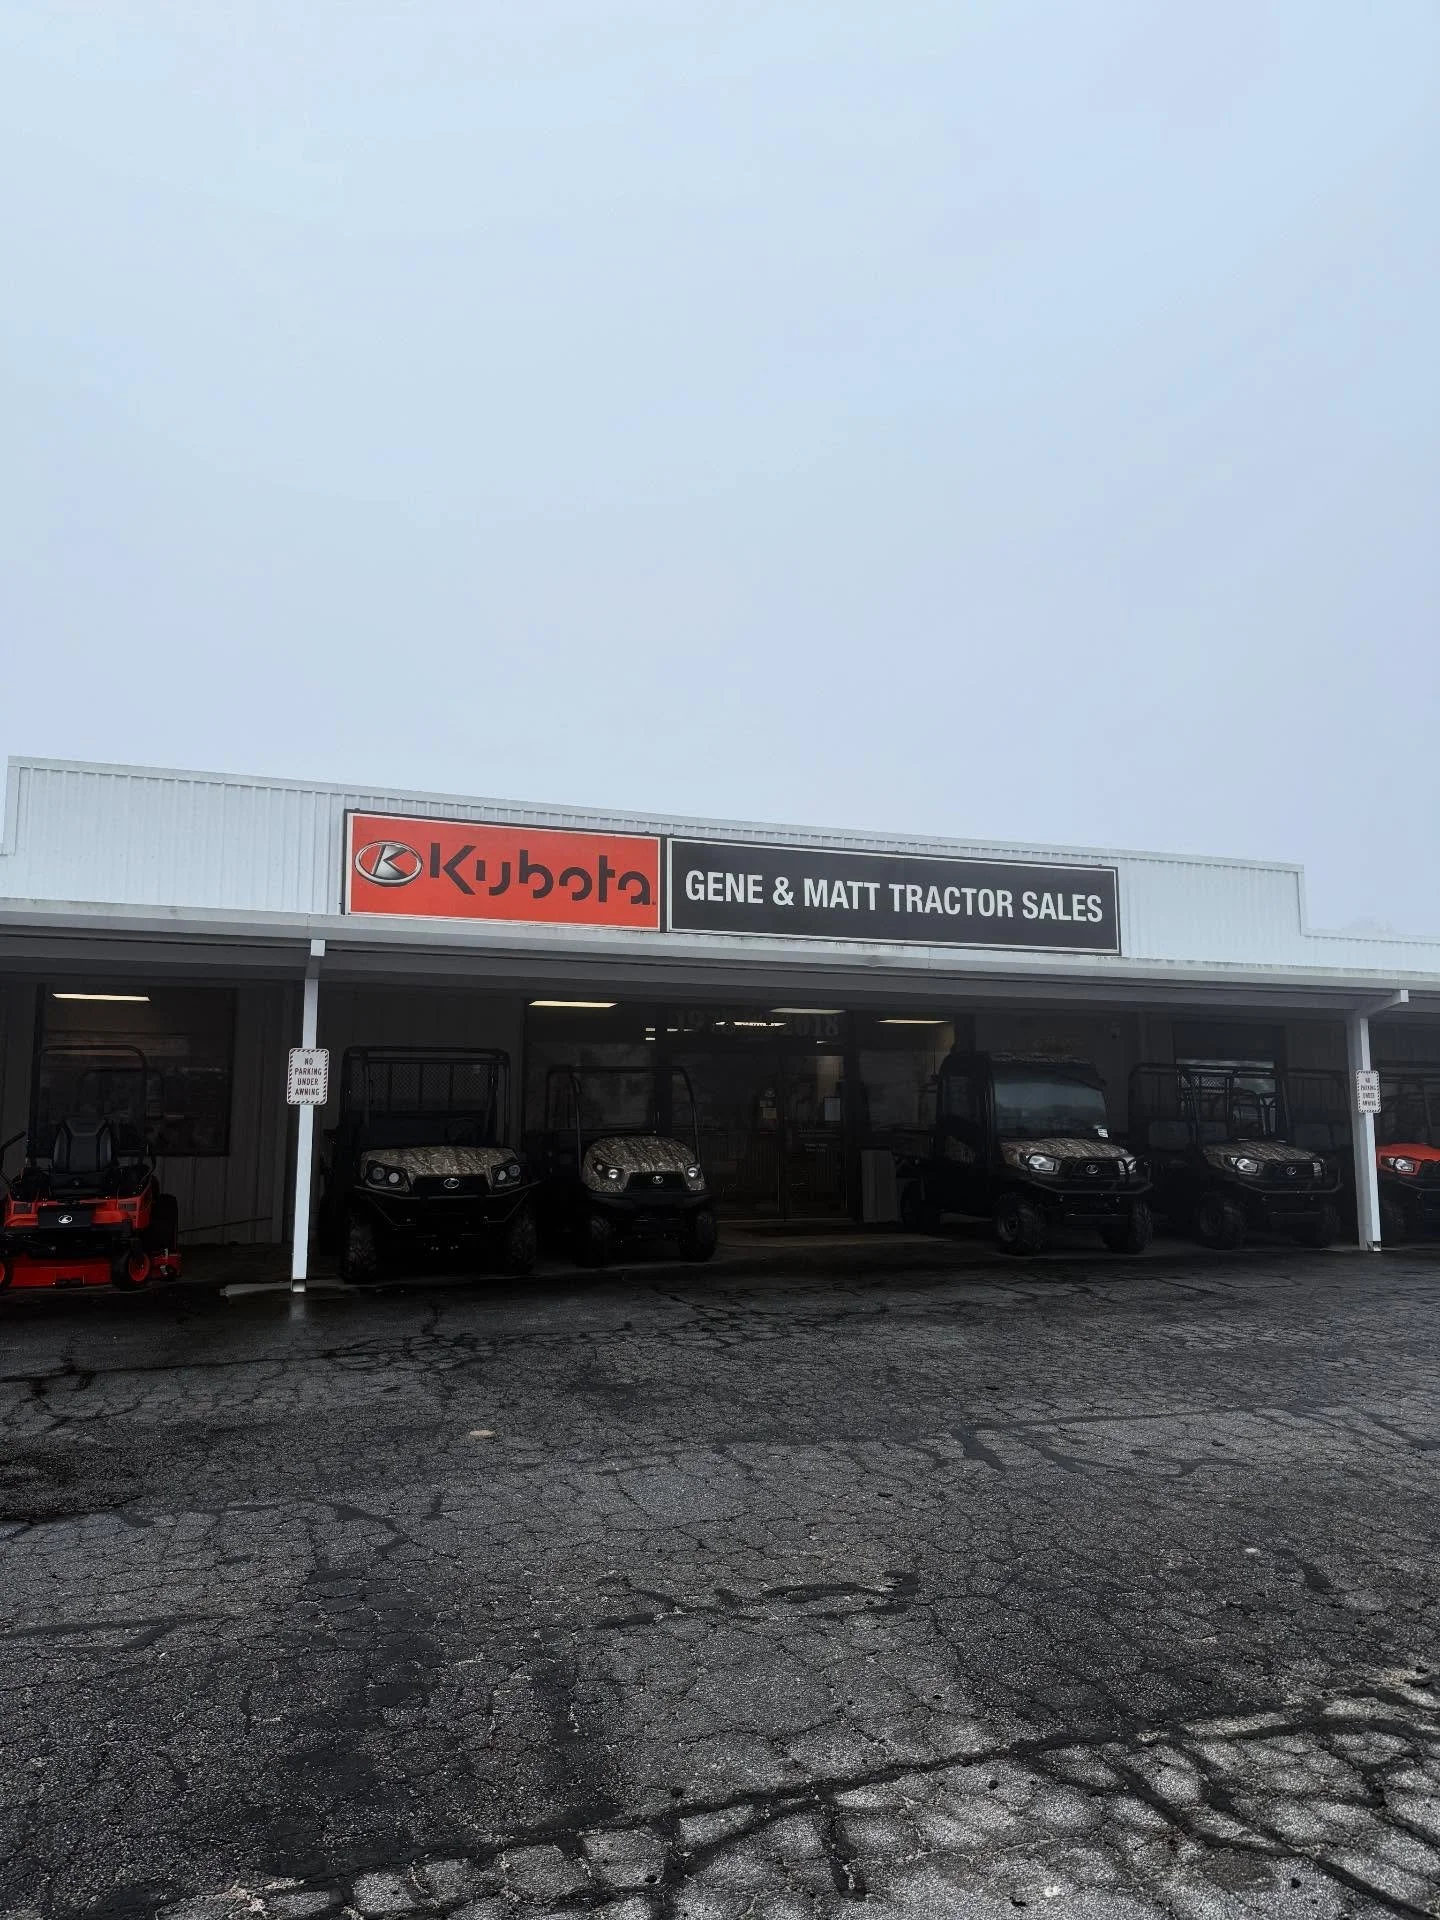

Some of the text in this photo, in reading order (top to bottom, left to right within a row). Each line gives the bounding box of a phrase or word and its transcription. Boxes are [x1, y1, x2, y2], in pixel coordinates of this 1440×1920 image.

[429, 842, 652, 905] Kubota
[685, 869, 1103, 923] GENE & MATT TRACTOR SALES
[304, 1057, 314, 1066] NO
[294, 1067, 322, 1076] PARKING
[297, 1078, 319, 1086] UNDER
[294, 1088, 320, 1096] AWNING
